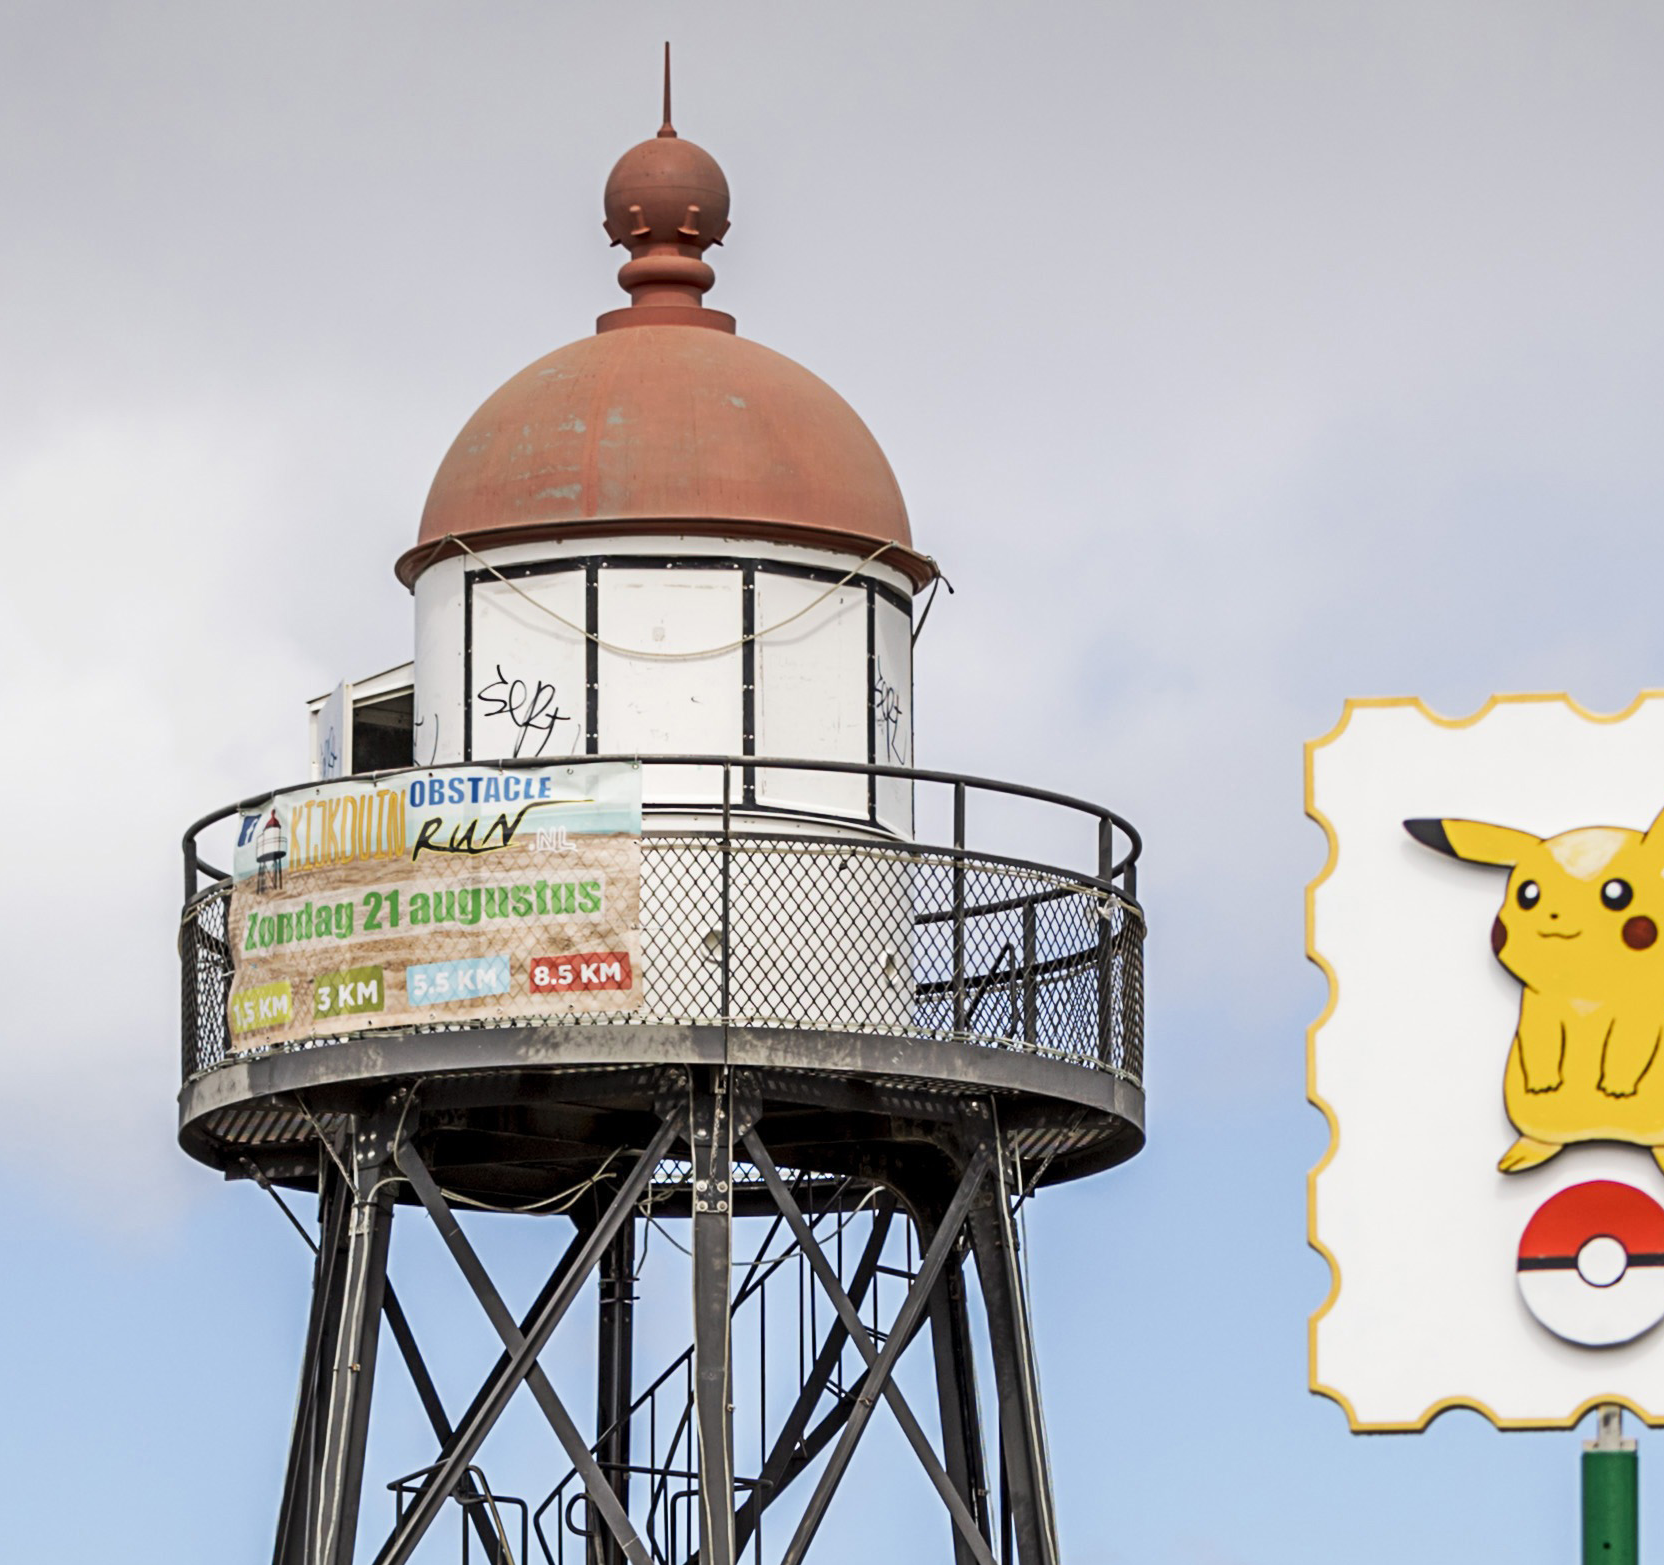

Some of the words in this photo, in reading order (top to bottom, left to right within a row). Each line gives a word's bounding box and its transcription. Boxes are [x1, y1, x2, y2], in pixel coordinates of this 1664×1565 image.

[409, 775, 552, 808] OBSTACLE
[288, 788, 407, 874] KIJKDUIN
[412, 799, 594, 862] RUN
[243, 900, 354, 952] Zondag
[362, 887, 401, 933] 21
[408, 878, 603, 926] augustus
[413, 972, 450, 997] 5.5
[457, 967, 498, 992] KM
[534, 966, 574, 987] 8.5
[580, 962, 622, 984] KM
[259, 994, 288, 1020] KM
[317, 986, 331, 1011] 3
[338, 979, 378, 1008] KM
